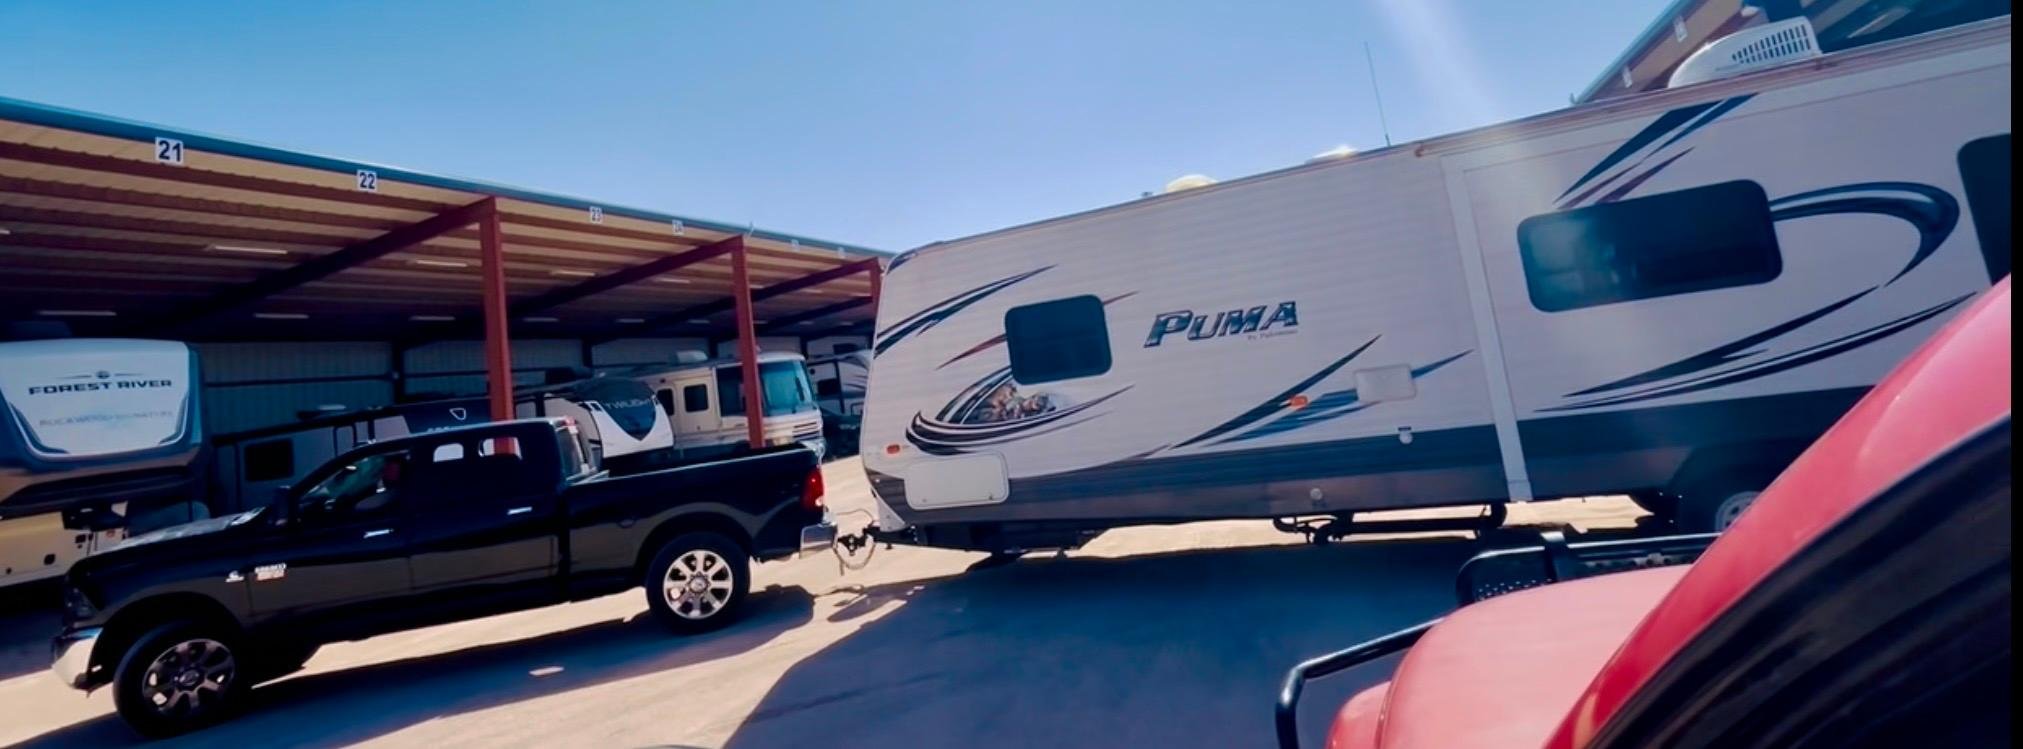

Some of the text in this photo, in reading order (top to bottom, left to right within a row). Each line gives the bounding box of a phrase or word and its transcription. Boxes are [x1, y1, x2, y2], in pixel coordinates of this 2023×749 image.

[158, 140, 183, 162] 21
[359, 172, 376, 189] 22
[1143, 301, 1298, 348] PUMA
[28, 379, 172, 395] FOREST RIVER
